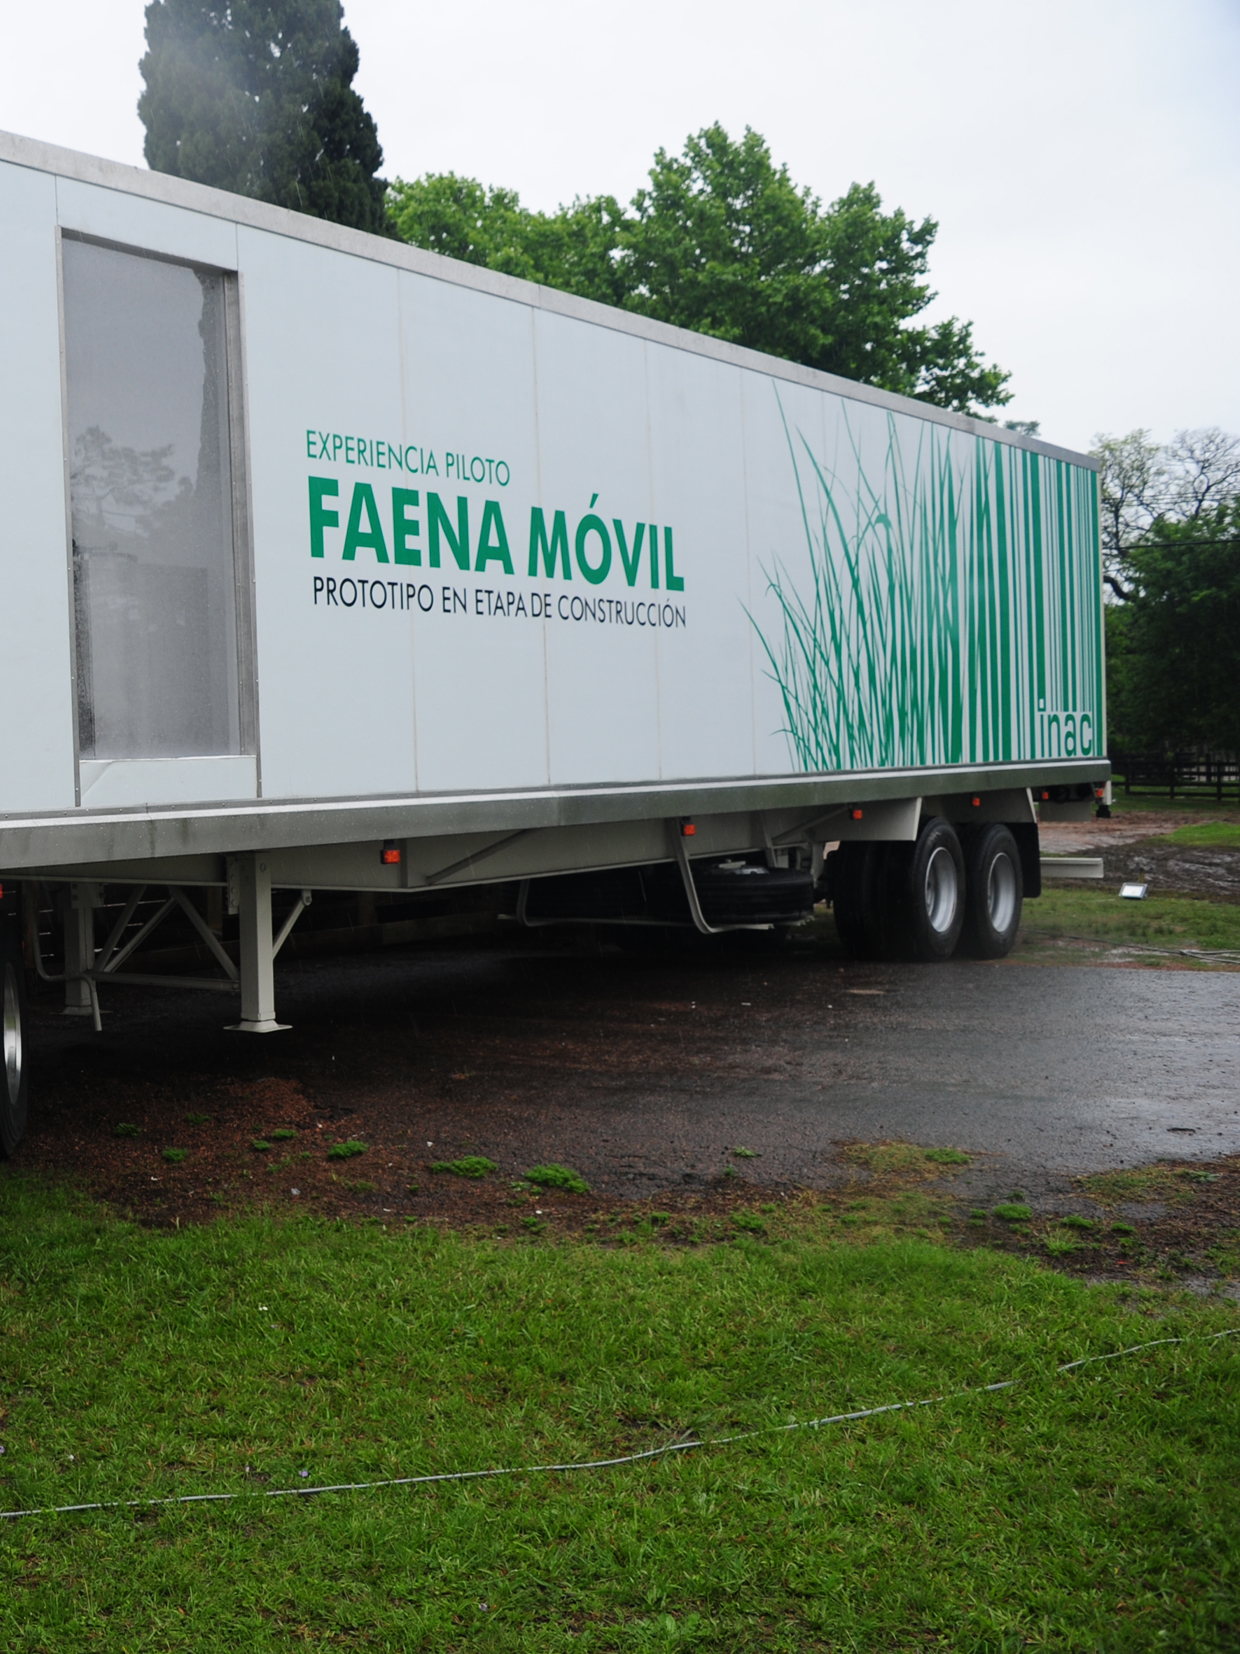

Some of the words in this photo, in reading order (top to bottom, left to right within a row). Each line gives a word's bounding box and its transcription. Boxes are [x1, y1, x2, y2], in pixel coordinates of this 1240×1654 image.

[306, 429, 439, 476] EXPERIENCIA
[446, 452, 510, 486] PILOTO
[308, 475, 515, 575] FAENA
[528, 493, 685, 592] MÓVIL
[313, 576, 434, 612] PROTOTIPO
[442, 586, 467, 614] EN
[475, 588, 528, 617] ETAPA
[531, 592, 552, 618] DE
[558, 595, 686, 628] CONSTRUCCIÓN
[1038, 698, 1092, 758] inac
